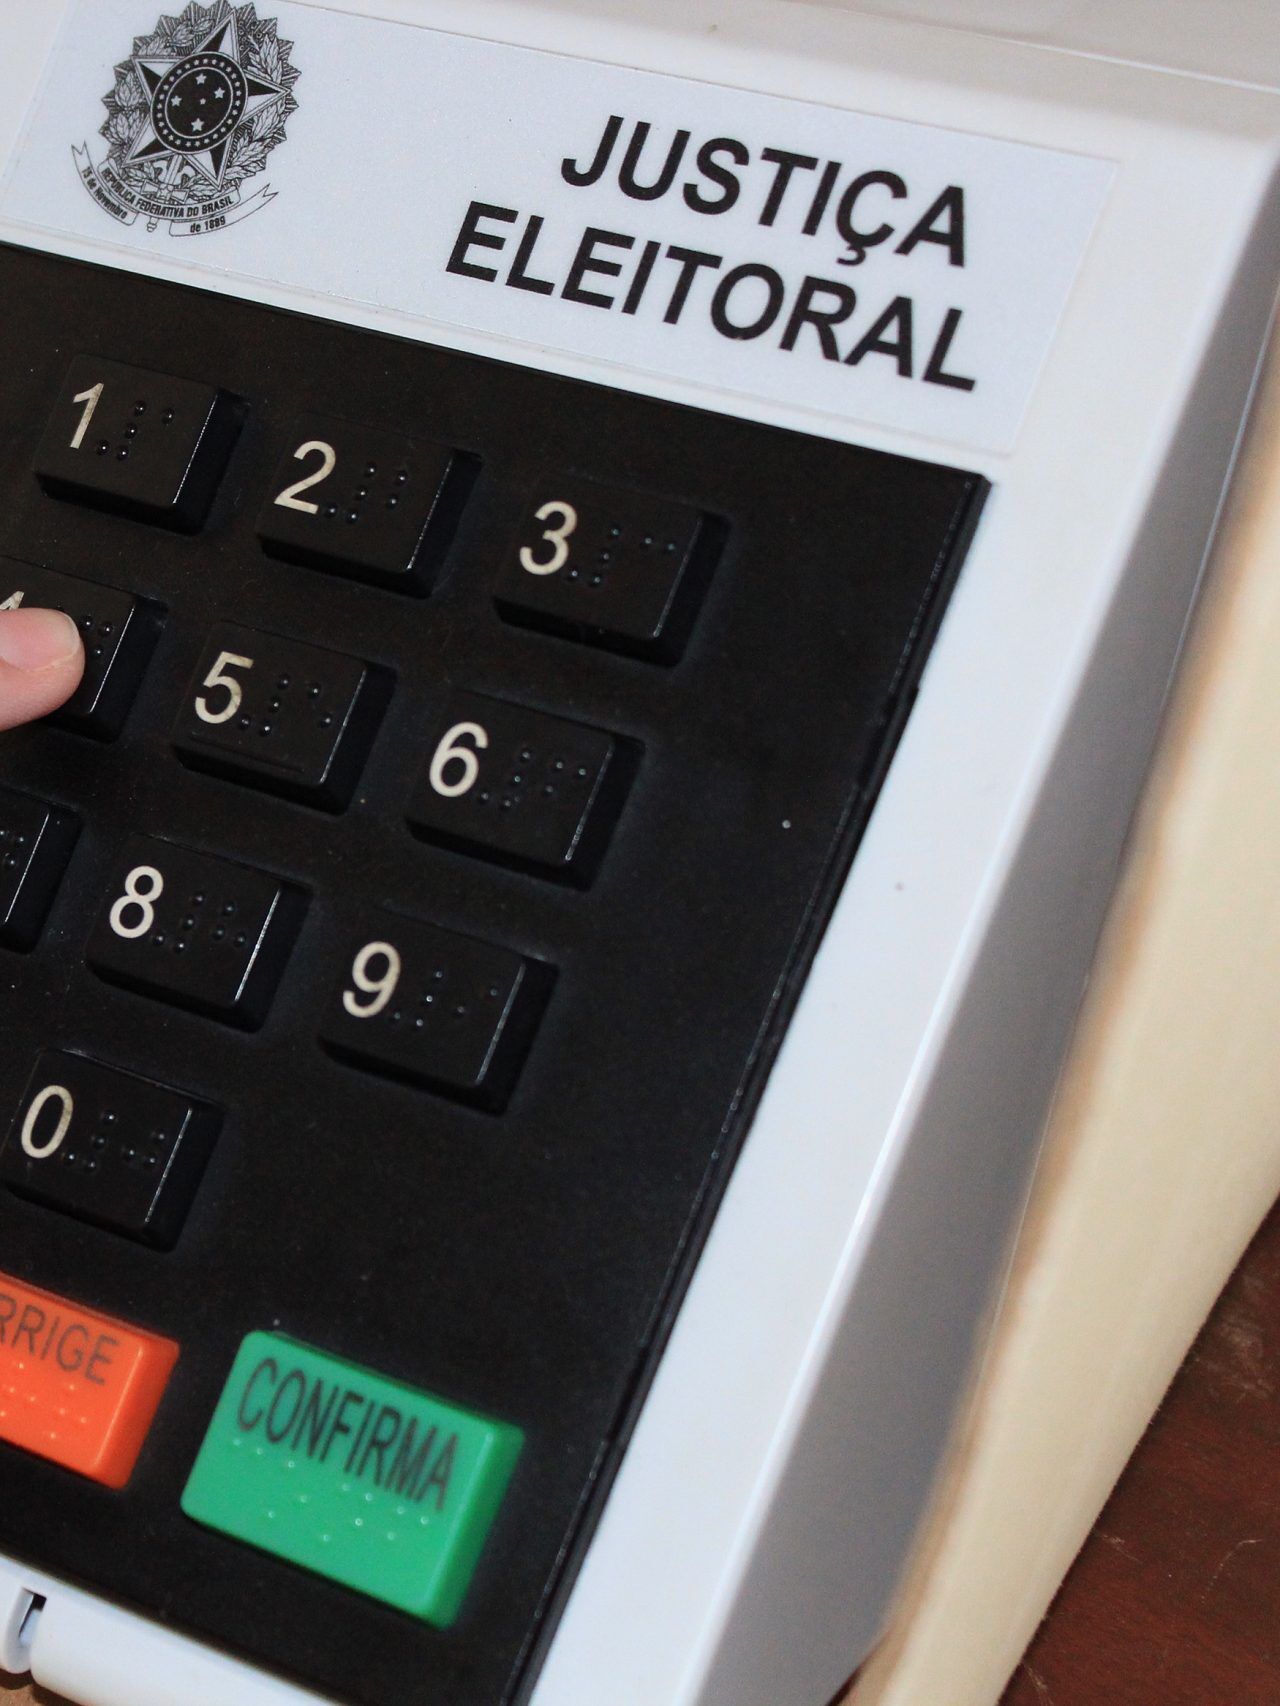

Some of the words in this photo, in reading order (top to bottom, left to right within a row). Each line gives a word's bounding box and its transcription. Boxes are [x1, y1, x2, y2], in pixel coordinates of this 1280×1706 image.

[136, 198, 184, 218] FEDERATIVA
[186, 206, 199, 218] DO
[201, 196, 233, 215] BRASIL
[190, 223, 201, 234] de
[204, 216, 226, 231] 1889
[560, 114, 966, 268] JUSTIÇA
[445, 200, 978, 392] ELEITORAL
[70, 382, 104, 449] 1
[274, 440, 337, 514] 2
[519, 500, 578, 575] 3
[194, 650, 254, 724] 5
[428, 721, 489, 797] 6
[109, 865, 164, 939] 8
[342, 941, 401, 1018] 9
[20, 1084, 74, 1159] 0
[236, 1357, 458, 1512] CONFIRMA
